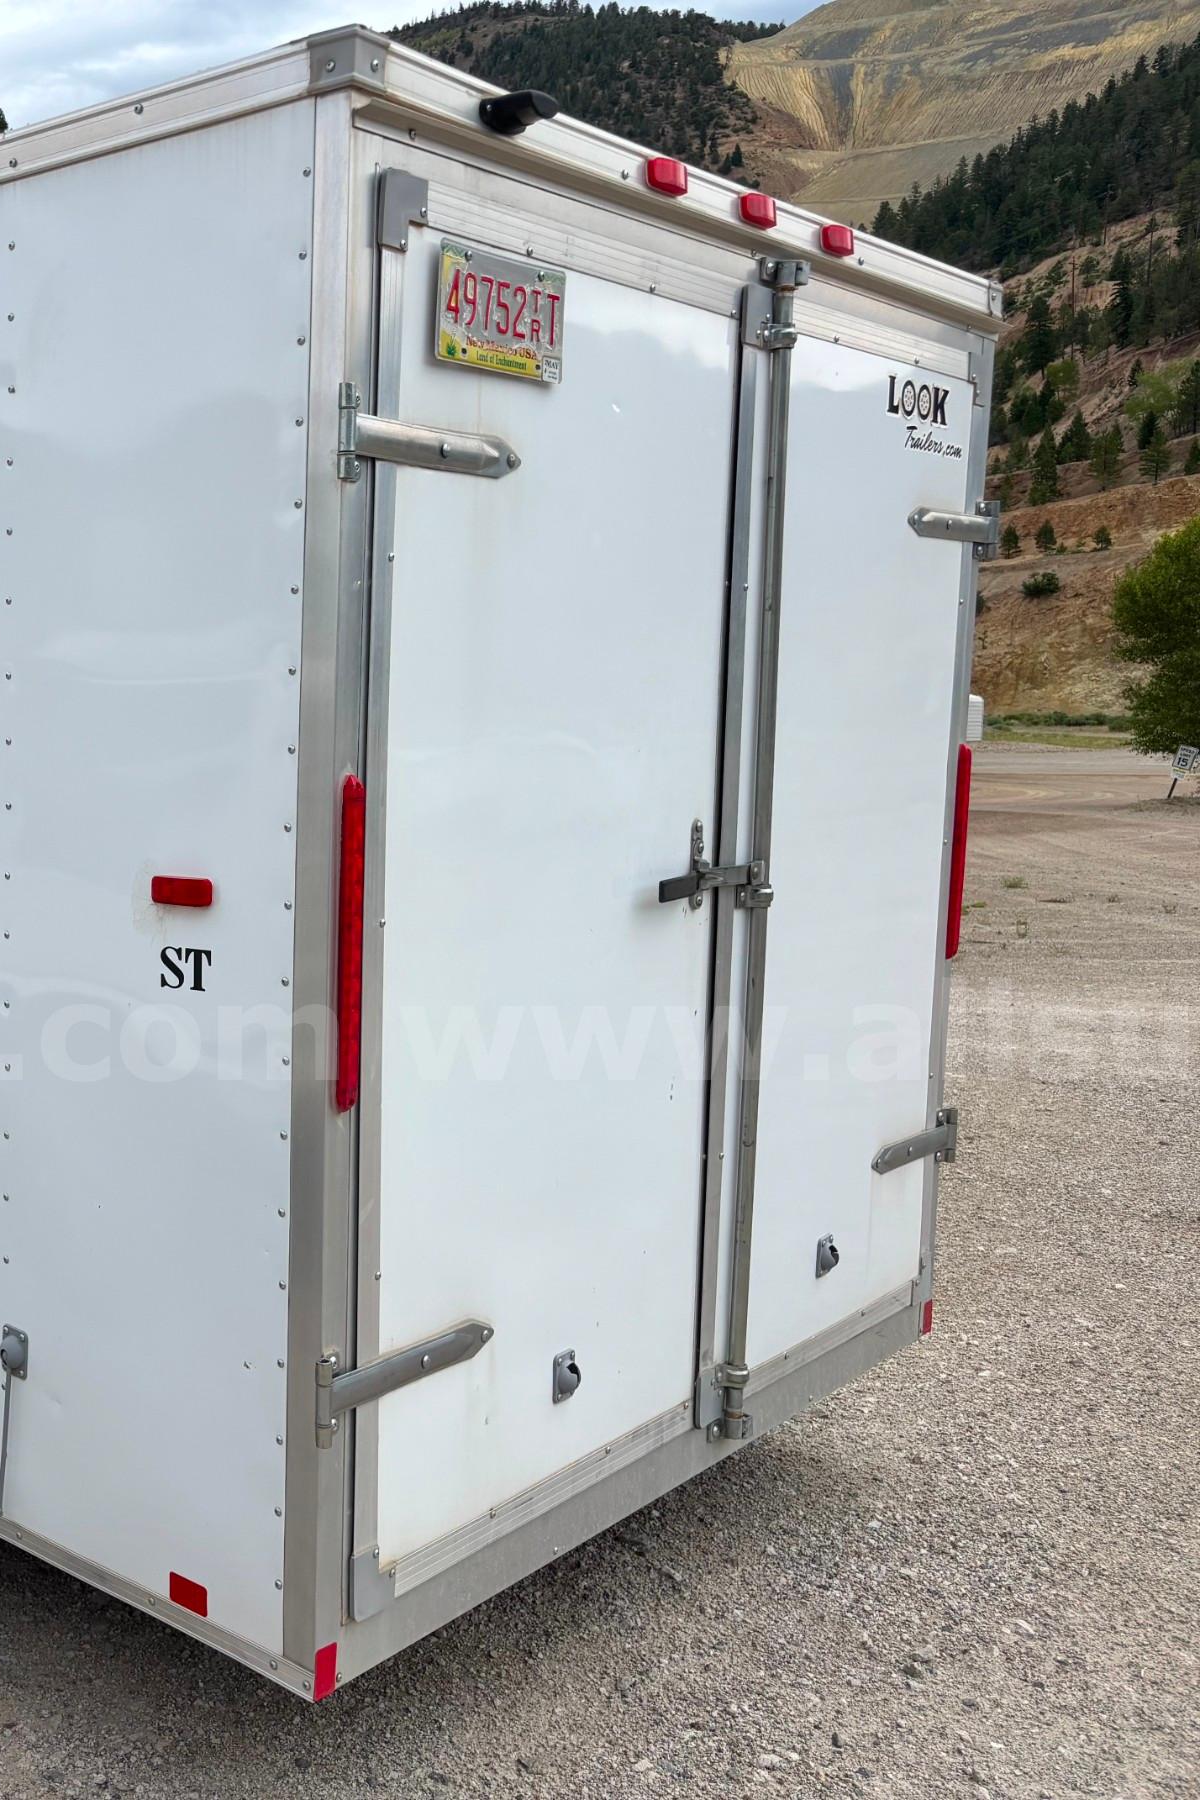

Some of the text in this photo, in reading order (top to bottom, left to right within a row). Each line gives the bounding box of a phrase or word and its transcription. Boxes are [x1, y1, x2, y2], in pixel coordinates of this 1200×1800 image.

[887, 375, 949, 426] LOOK
[1177, 757, 1189, 767] 15
[160, 946, 212, 992] ST
